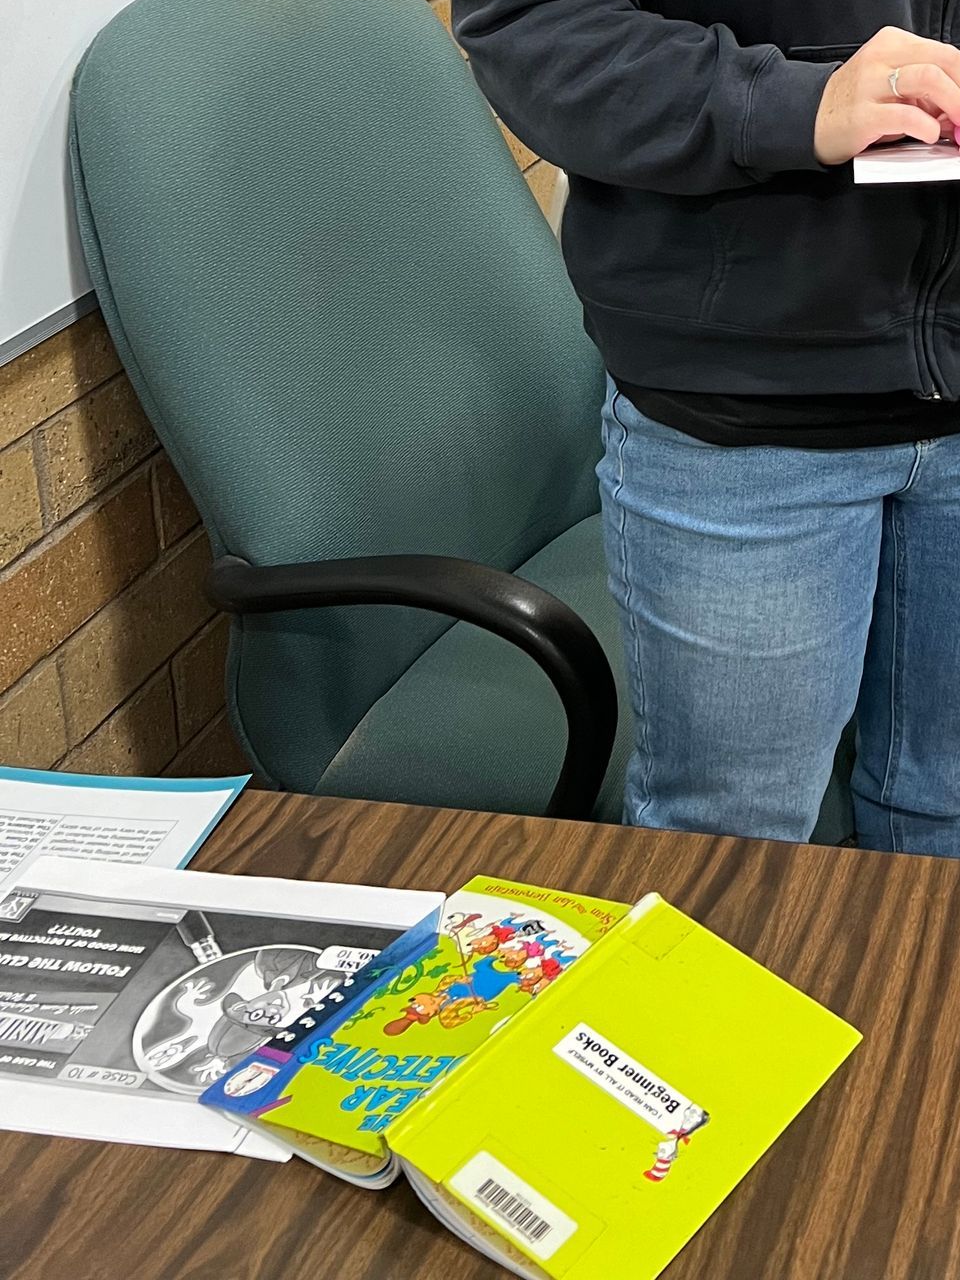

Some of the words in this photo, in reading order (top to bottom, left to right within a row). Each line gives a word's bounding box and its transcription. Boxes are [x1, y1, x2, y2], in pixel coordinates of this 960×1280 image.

[47, 924, 101, 938] YOU???
[9, 934, 65, 945] DETECTIVE
[64, 938, 74, 946] A
[71, 940, 88, 948] OF
[87, 941, 118, 951] GOOD
[116, 945, 146, 953] HOW
[336, 950, 353, 959] 10
[60, 961, 131, 977] FOLLOW
[335, 960, 369, 970] ASE
[575, 1032, 620, 1068] Books
[36, 1059, 56, 1069] THE
[567, 1050, 594, 1068] MYSELF
[68, 1067, 85, 1079] 10
[593, 1067, 605, 1076] BY
[101, 1072, 138, 1085] Case
[605, 1073, 618, 1085] ALL
[617, 1064, 681, 1114] Beginner
[340, 1085, 427, 1113] EAR
[624, 1089, 644, 1105] READ
[643, 1103, 659, 1116] CAN
[356, 1113, 394, 1133] HE
